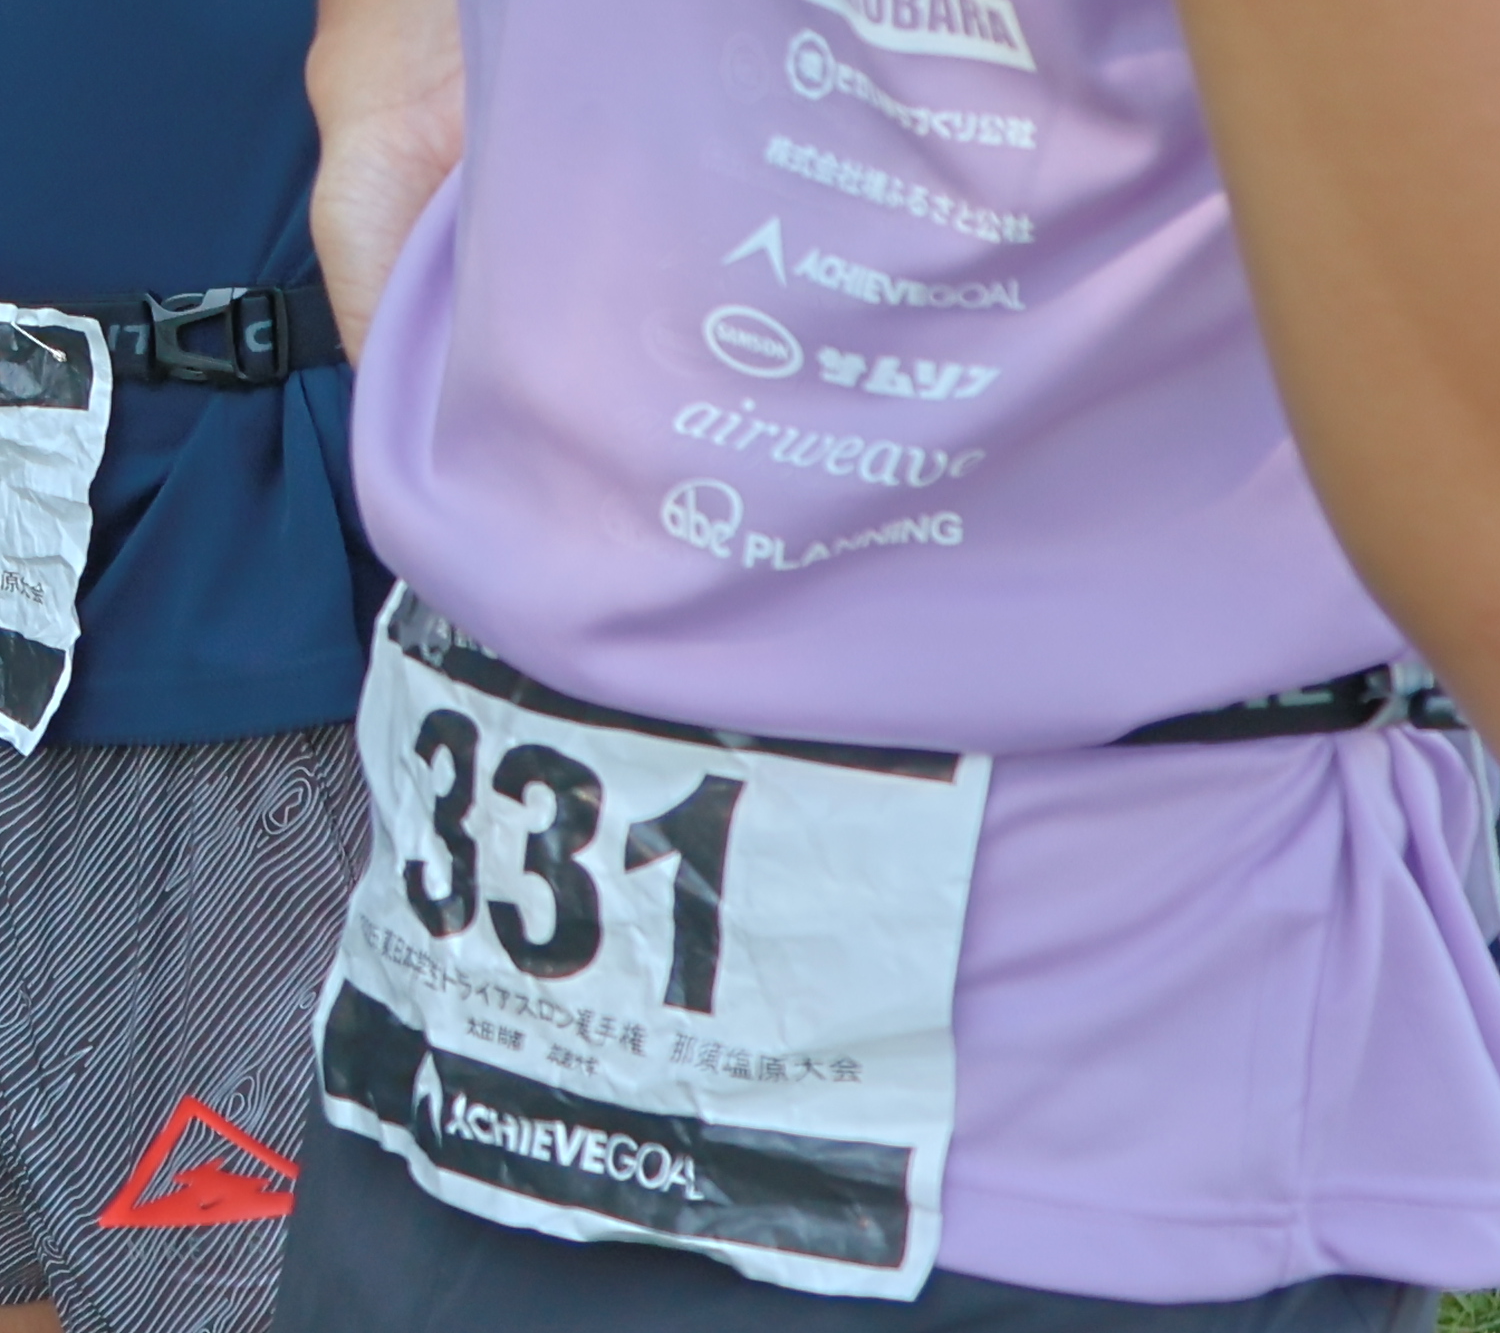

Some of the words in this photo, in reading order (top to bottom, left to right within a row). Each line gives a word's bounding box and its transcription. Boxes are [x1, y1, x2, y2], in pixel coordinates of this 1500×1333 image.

[672, 398, 987, 489] airweave
[743, 510, 964, 571] PLANNING
[404, 708, 750, 1018] 331
